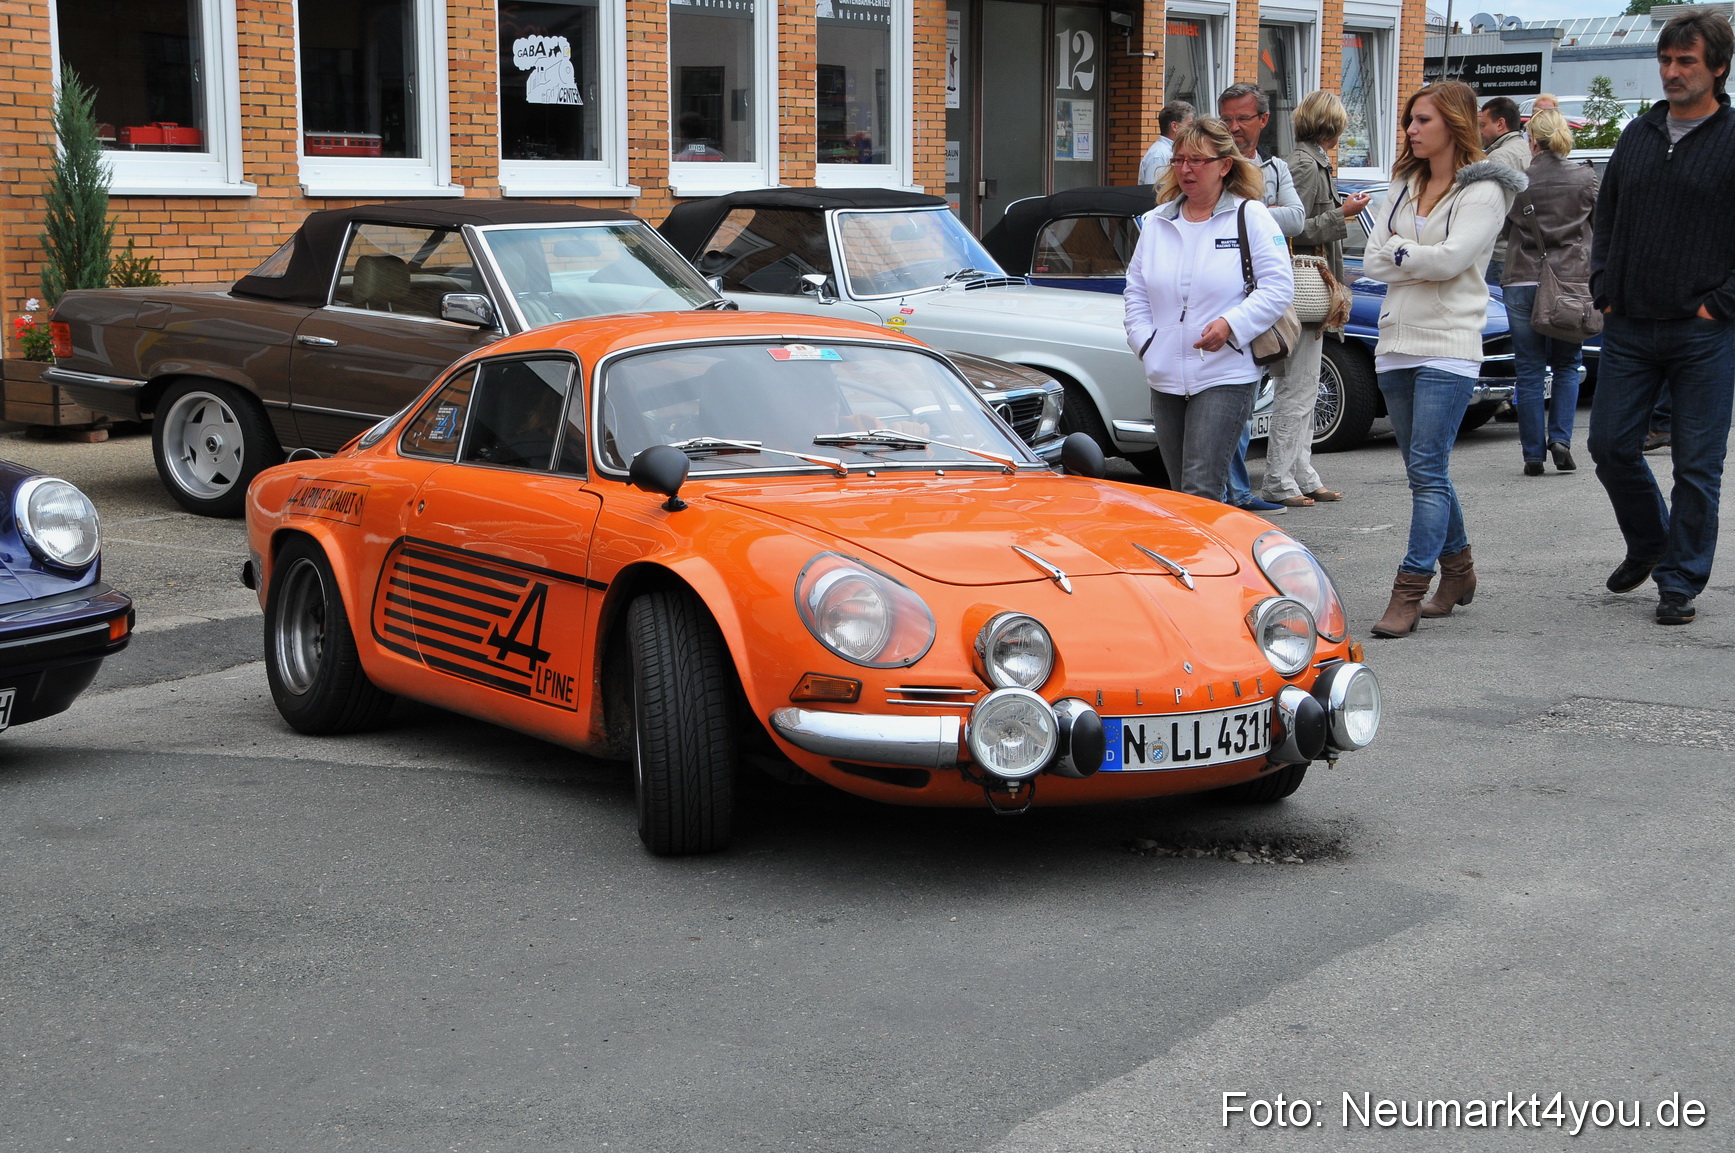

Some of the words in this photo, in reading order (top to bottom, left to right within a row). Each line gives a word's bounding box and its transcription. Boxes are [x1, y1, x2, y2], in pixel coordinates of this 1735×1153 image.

[838, 9, 890, 25] Nürnberg
[517, 42, 546, 57] GABA
[1056, 29, 1095, 91] 12
[1475, 63, 1538, 76] Jahreswagen
[1482, 79, 1537, 88] www.carsearch.de
[319, 488, 358, 515] RENAULT
[1095, 677, 1265, 706] ALPINE
[1123, 724, 1146, 765] N
[1171, 720, 1212, 762] LL
[1217, 706, 1273, 756] 431H
[1105, 750, 1115, 763] D
